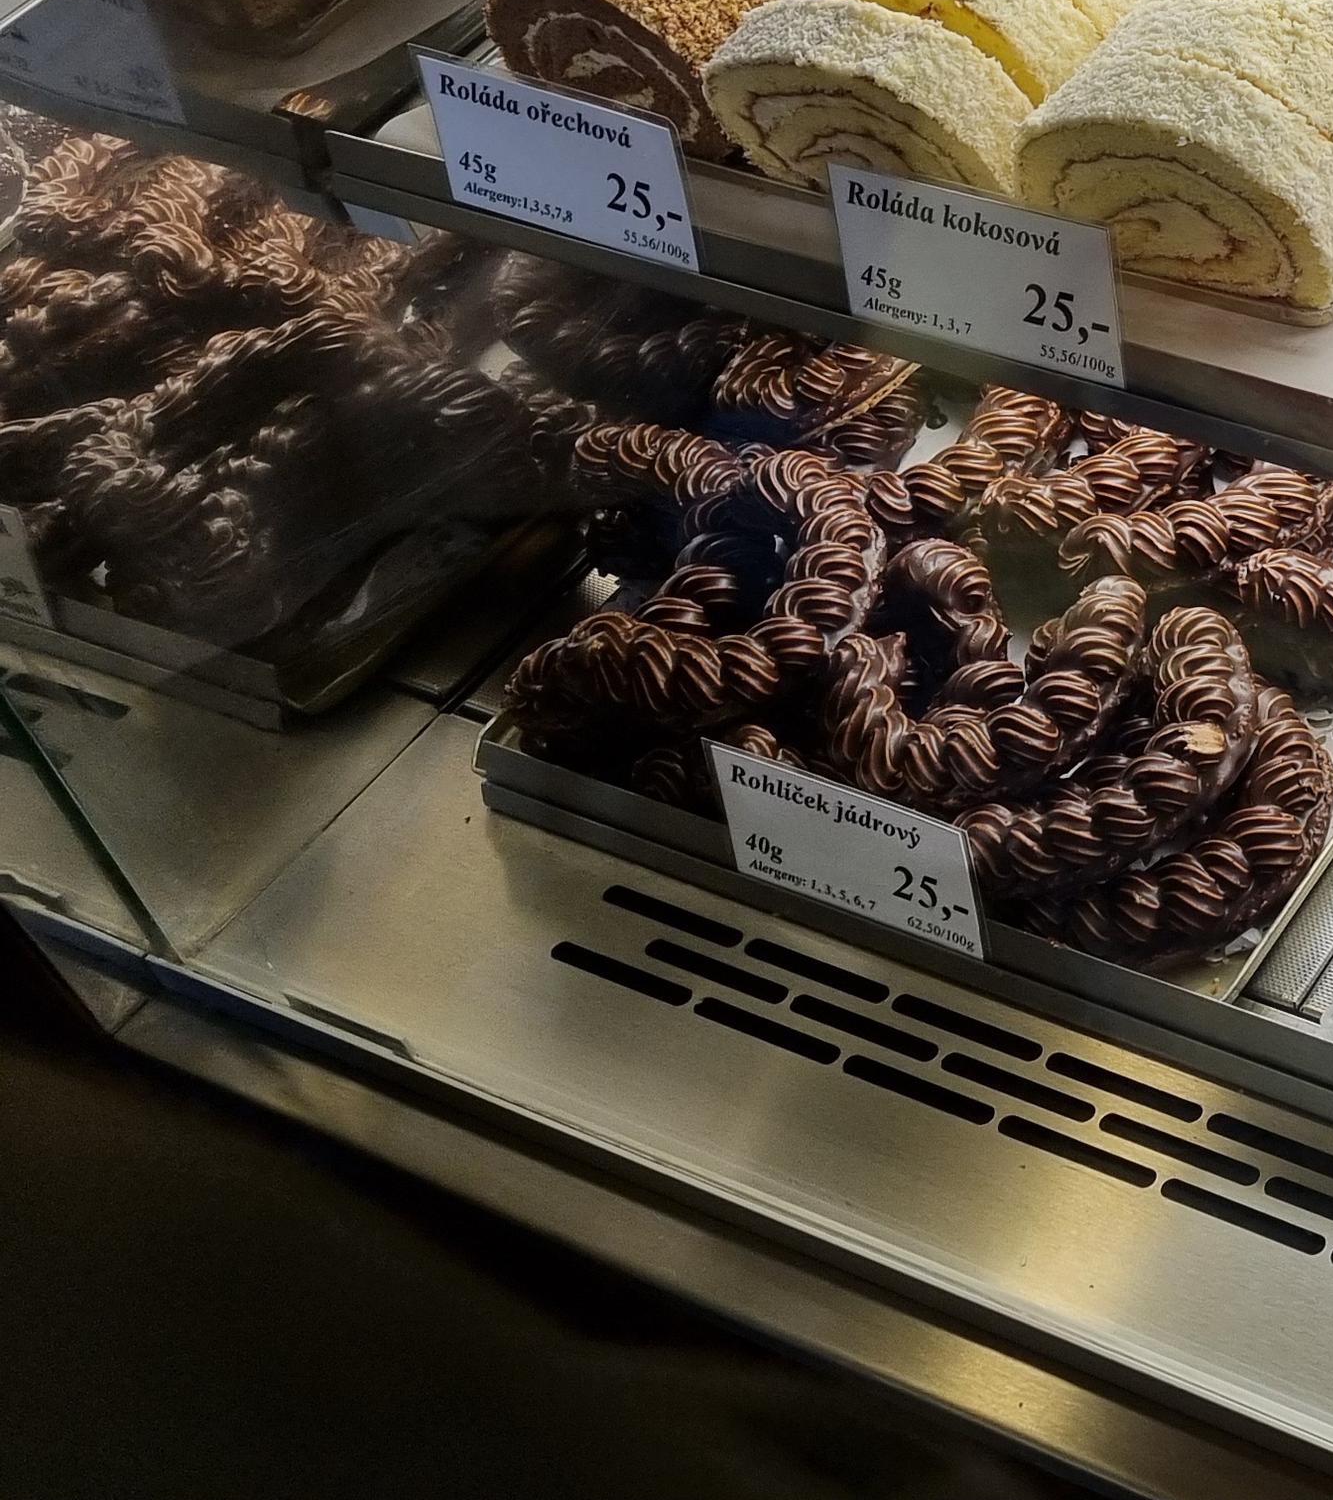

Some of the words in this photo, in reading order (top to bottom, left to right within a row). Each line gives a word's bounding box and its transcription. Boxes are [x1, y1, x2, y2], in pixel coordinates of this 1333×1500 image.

[439, 73, 521, 115] Roláda
[527, 102, 632, 148] ořechová
[459, 151, 498, 184] 45g
[606, 172, 683, 231] 25,-
[846, 180, 935, 224] Roláda
[942, 204, 1061, 256] kokosová
[623, 229, 690, 265] 55,56/100g
[860, 264, 902, 300] 45g
[863, 297, 928, 325] Alergeny:
[932, 313, 944, 330] 1,
[947, 318, 960, 335] 3,
[965, 322, 972, 335] 7
[1023, 283, 1110, 345] 25,-
[1040, 343, 1116, 379] 55,56/100g
[731, 763, 830, 815] Rohlíček
[833, 800, 921, 849] jádrový
[745, 833, 784, 865] 40g
[749, 859, 807, 887] Alergeny:
[868, 900, 876, 910] 7
[892, 865, 969, 921] 25,-
